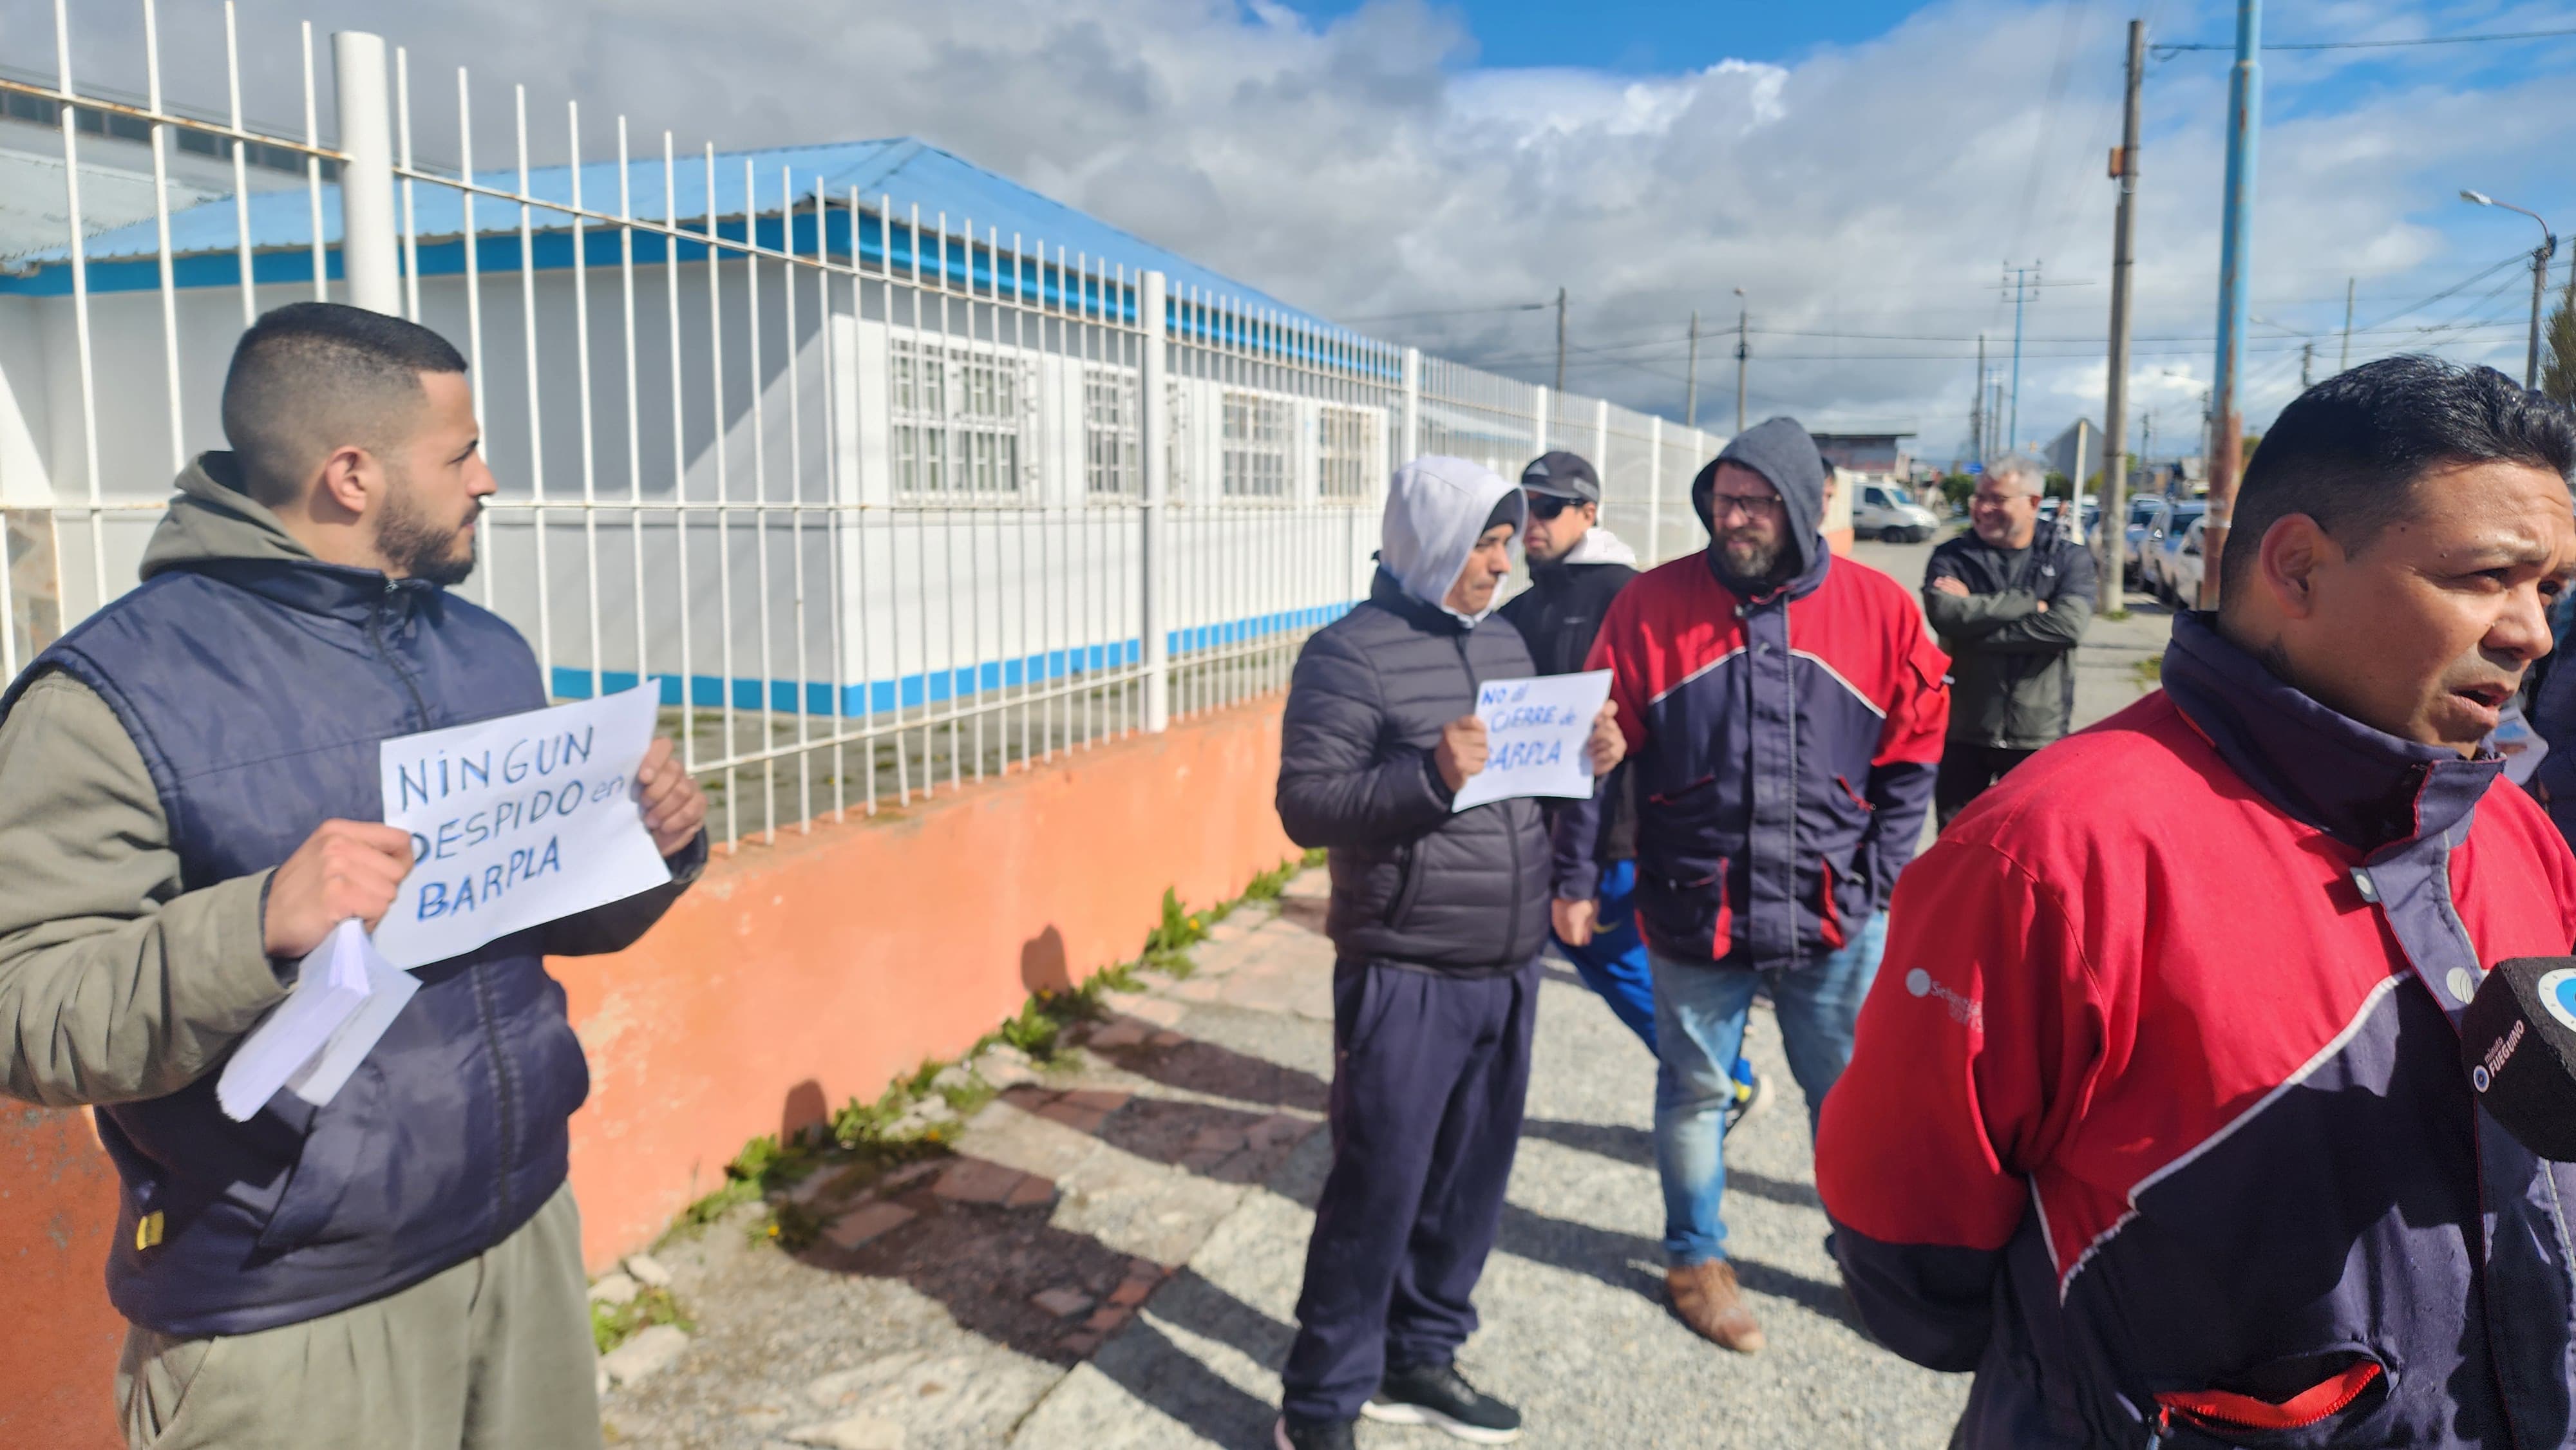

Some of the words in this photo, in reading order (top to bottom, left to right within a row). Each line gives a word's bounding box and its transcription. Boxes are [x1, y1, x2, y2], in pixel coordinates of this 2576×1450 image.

[1481, 688, 1507, 706] NO
[590, 775, 625, 803] en
[417, 834, 562, 922] BARPLA
[2485, 1036, 2503, 1064] minuto
[2488, 1019, 2524, 1077] FUEGUINO
